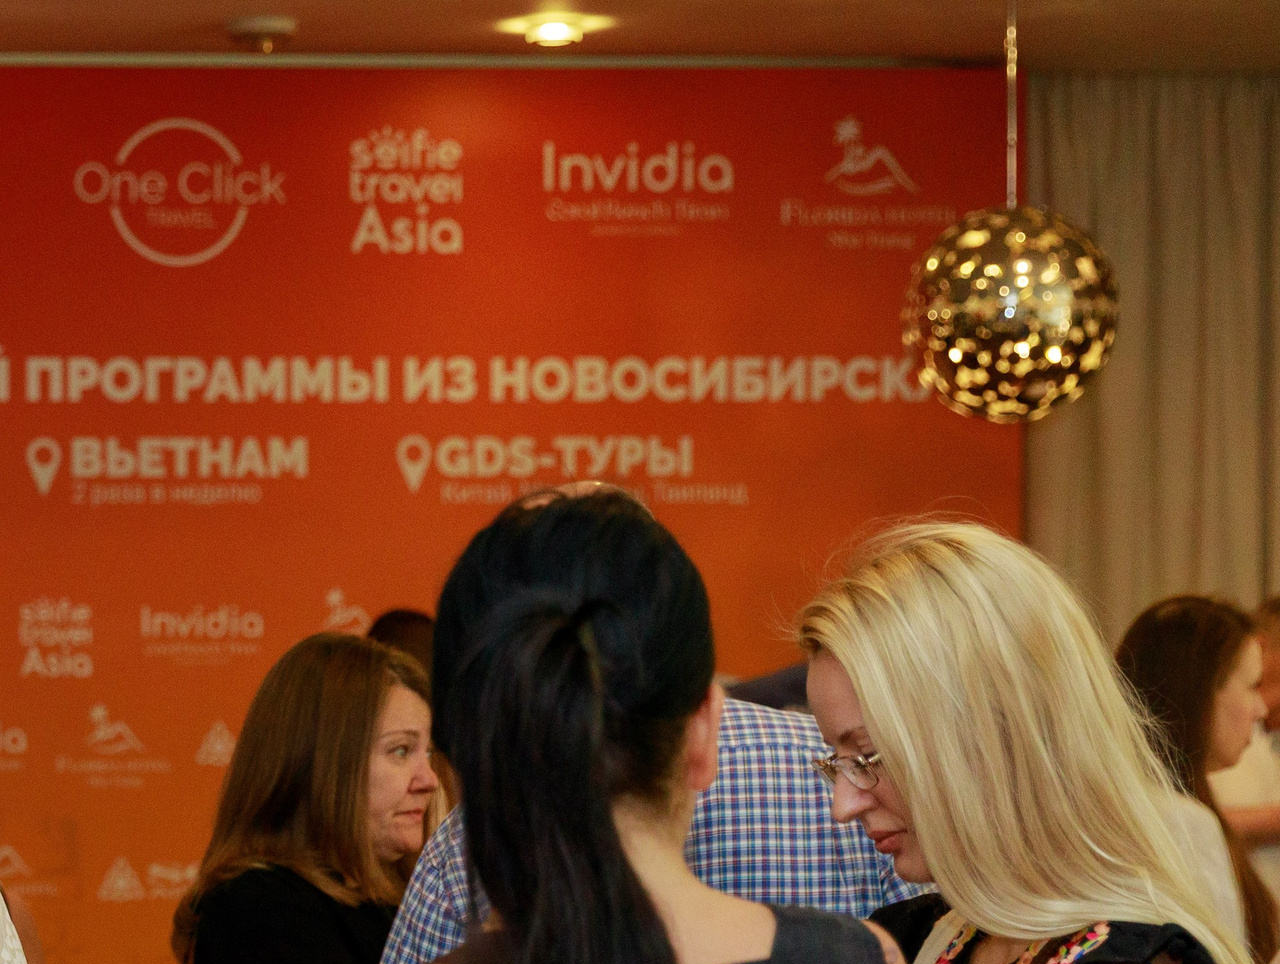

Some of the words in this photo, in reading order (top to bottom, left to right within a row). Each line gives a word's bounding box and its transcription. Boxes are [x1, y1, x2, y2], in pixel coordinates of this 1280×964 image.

[73, 161, 168, 204] One
[178, 161, 287, 204] Click
[349, 170, 463, 203] travel
[542, 140, 735, 194] Invidia
[351, 203, 463, 254] Asia
[25, 356, 390, 403] ПРОГРАММЫ
[402, 356, 477, 403] ИЗ
[489, 355, 928, 403] НОВОСИБИРСК
[70, 436, 310, 478] ВЬЕТНАМ
[436, 435, 695, 477] GDS-ТУРЫ
[139, 604, 265, 639] Invidia
[20, 647, 94, 678] Asia
